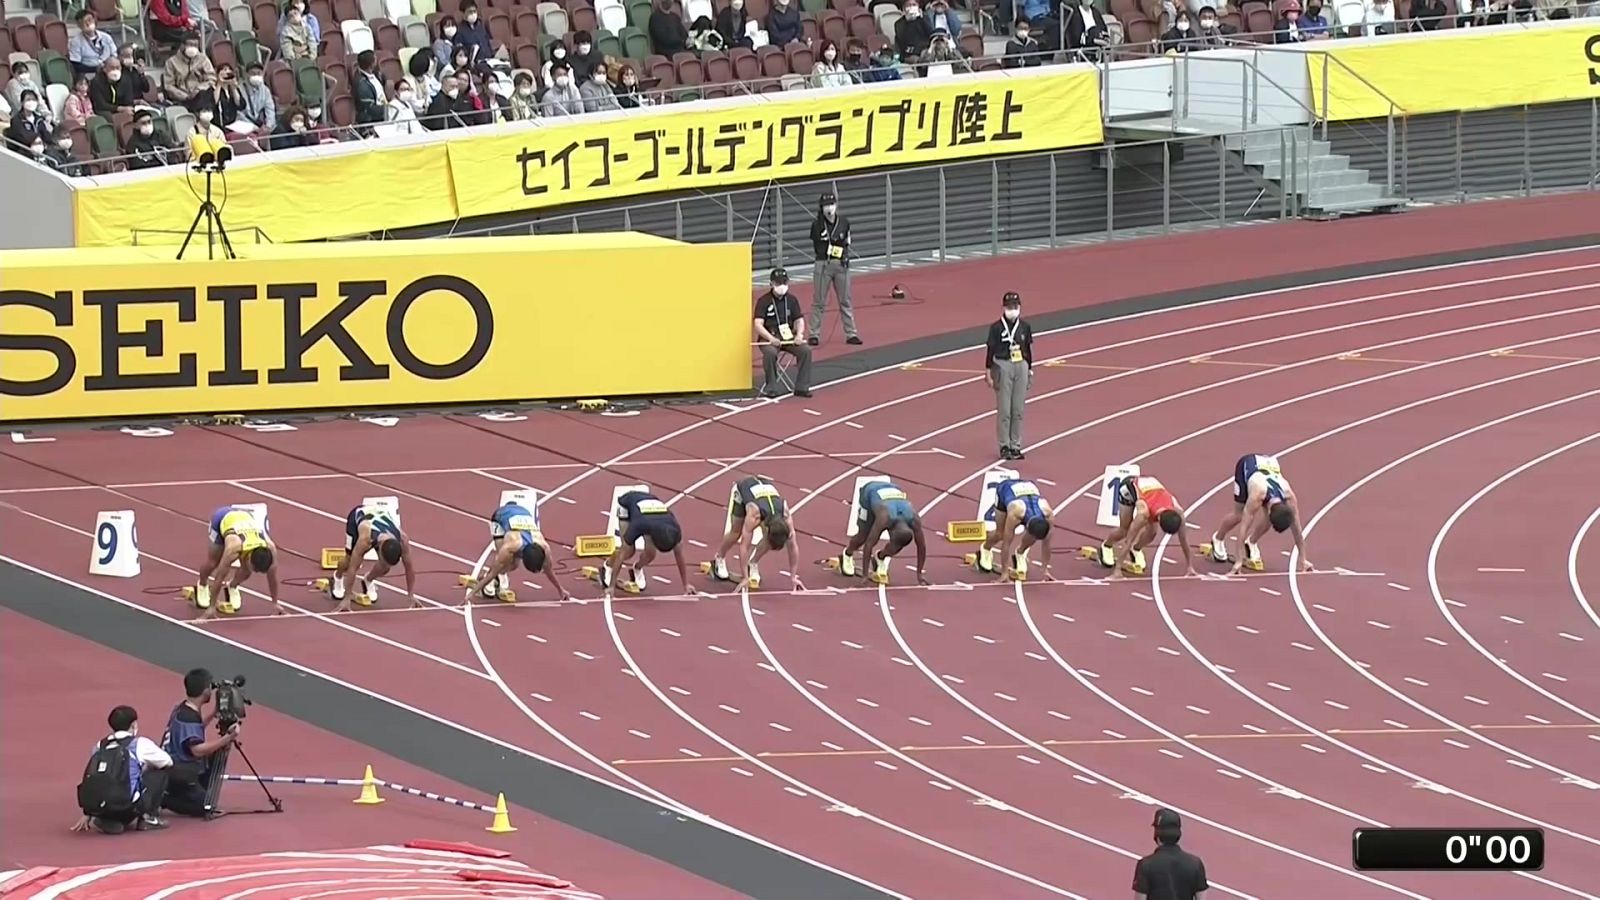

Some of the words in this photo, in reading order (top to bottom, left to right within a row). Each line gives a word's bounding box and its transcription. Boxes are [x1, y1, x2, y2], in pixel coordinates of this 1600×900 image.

[516, 90, 1023, 195] セイコーゴールデングランプリ陸上
[0, 274, 494, 396] SEIKO
[1107, 476, 1121, 516] 1
[98, 522, 118, 565] 9
